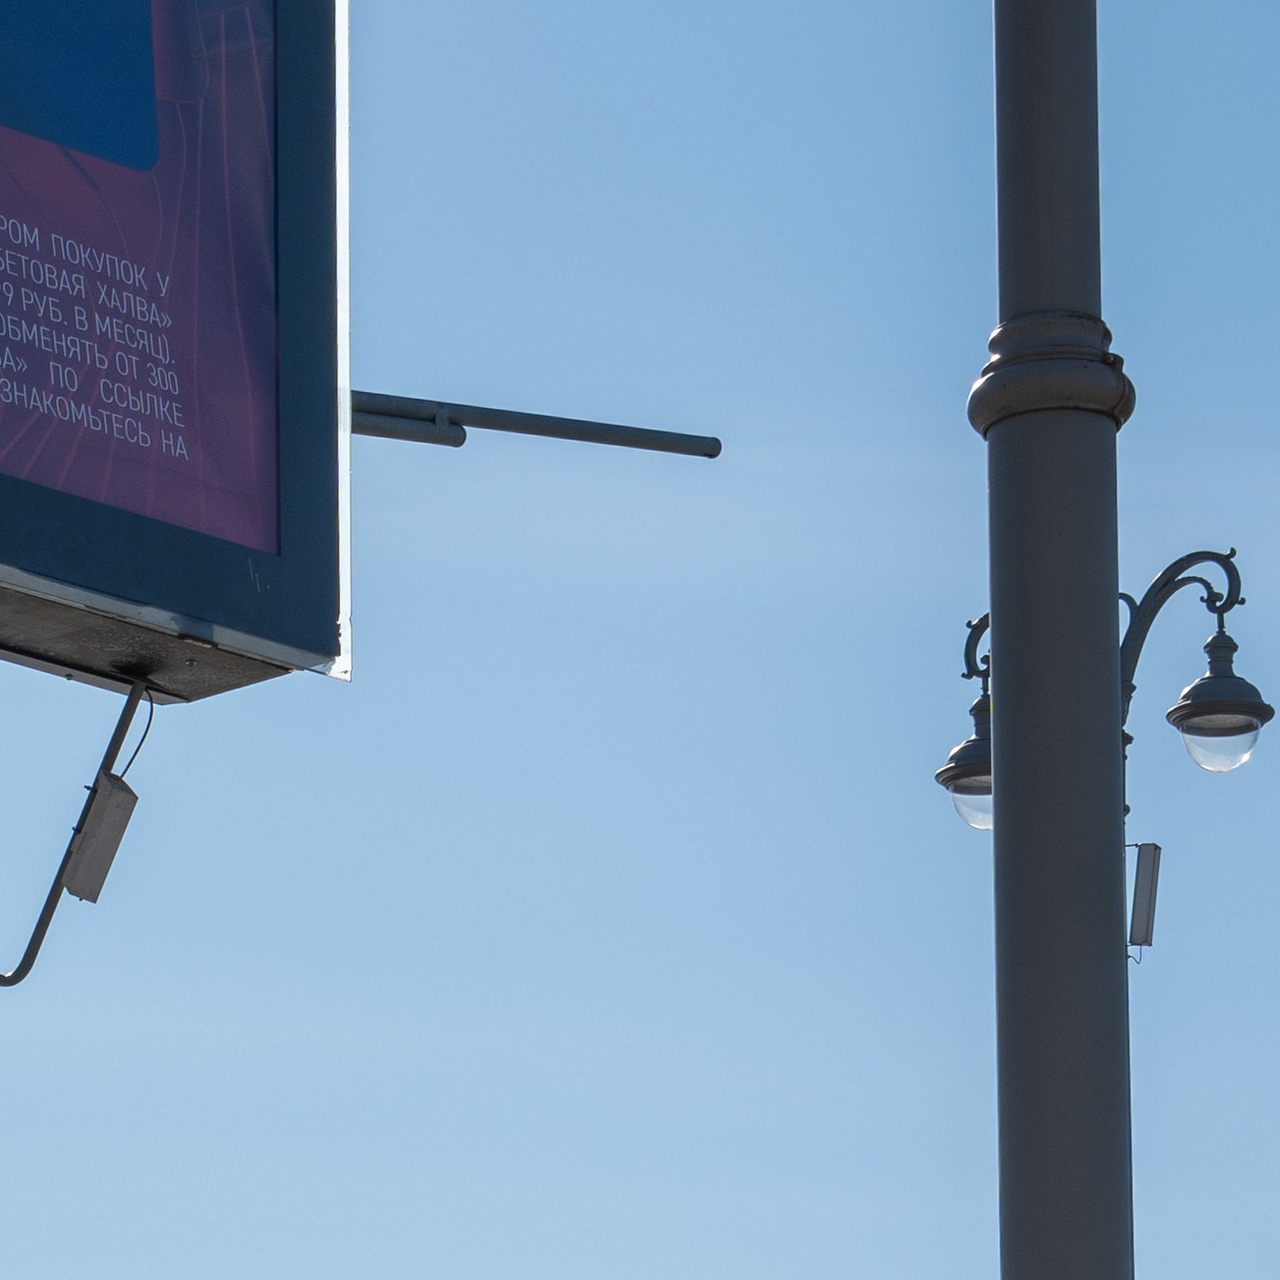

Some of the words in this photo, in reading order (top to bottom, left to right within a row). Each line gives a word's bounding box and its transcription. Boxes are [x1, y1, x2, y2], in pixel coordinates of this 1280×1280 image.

[51, 234, 147, 290] ПОКУПОК
[157, 272, 169, 296] У
[21, 288, 67, 325] РУБ.
[75, 306, 88, 330] В
[95, 312, 175, 364] МЕСЯЦ).
[97, 281, 172, 327] ХАЛВА»
[50, 361, 78, 391] ПО
[100, 379, 184, 427] ССЫЛКЕ
[116, 352, 139, 379] ОТ
[147, 363, 178, 394] 300
[162, 430, 188, 460] НА
